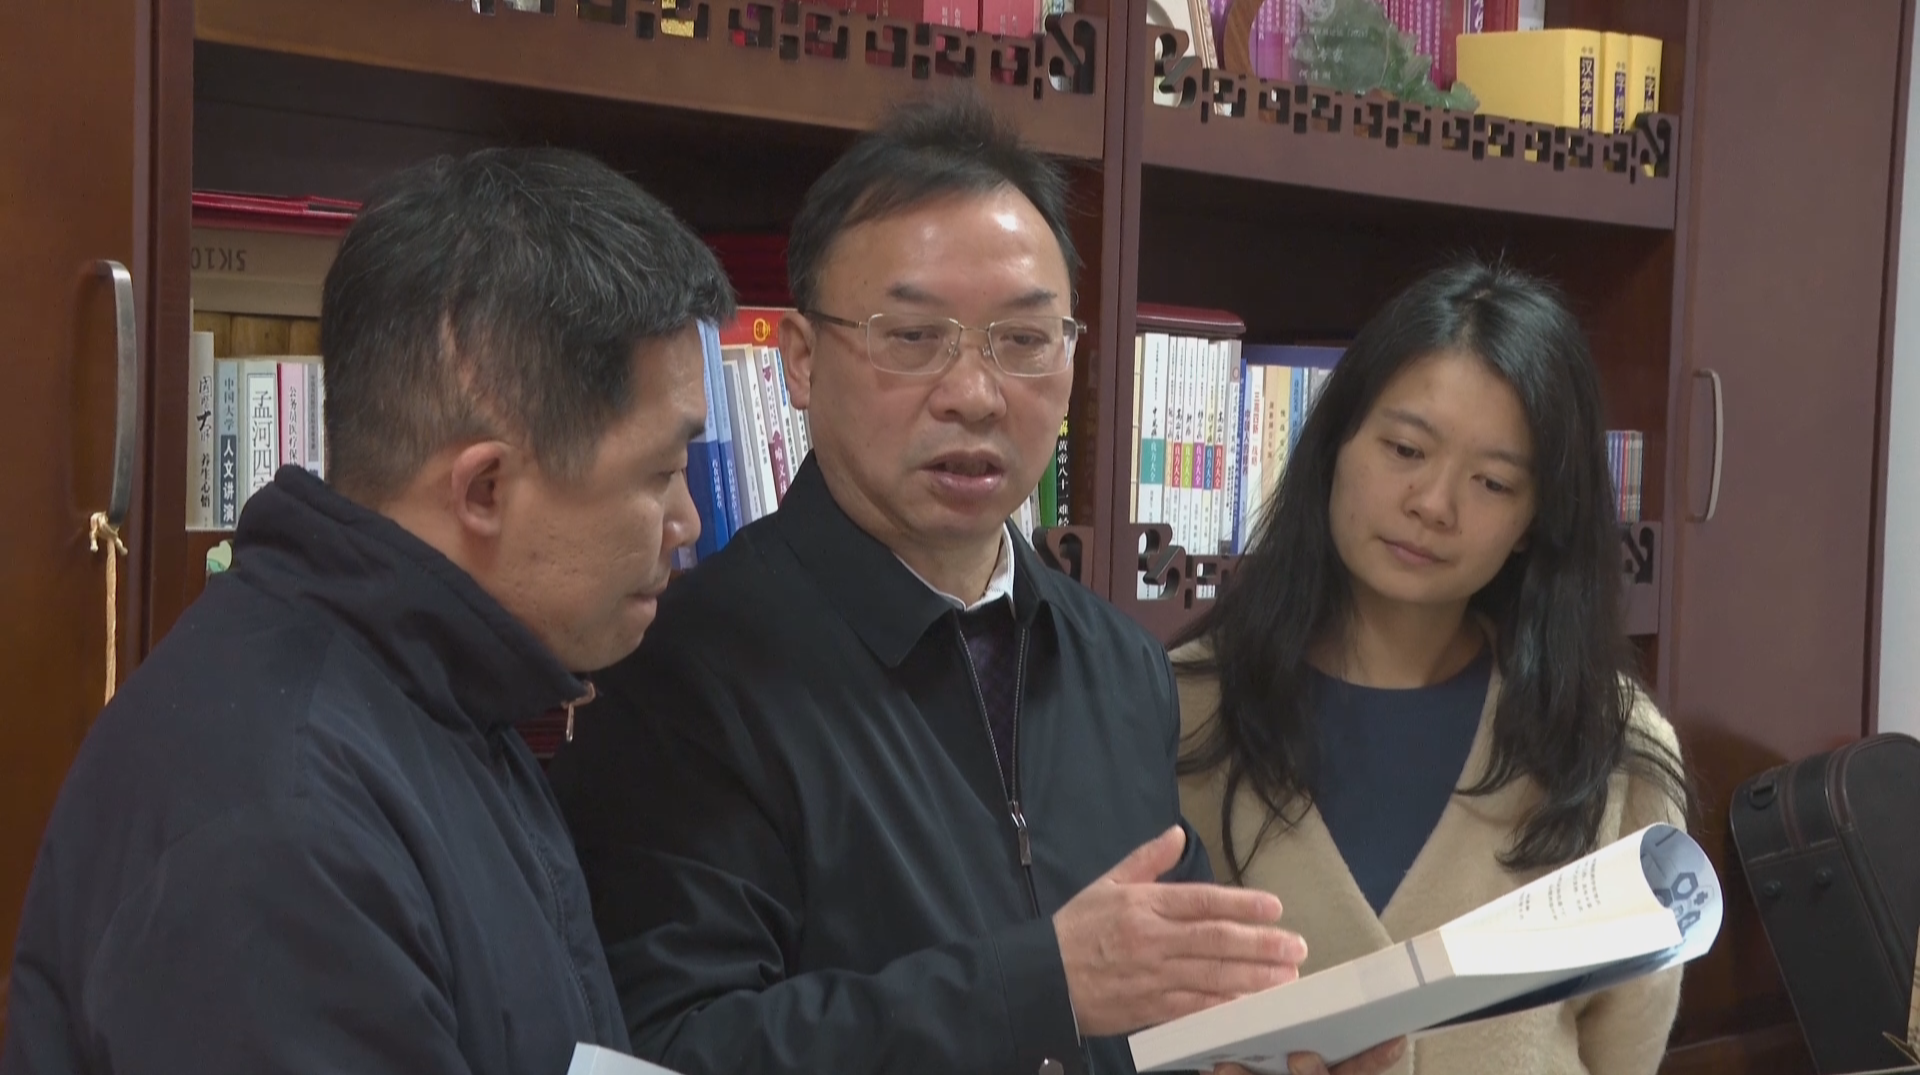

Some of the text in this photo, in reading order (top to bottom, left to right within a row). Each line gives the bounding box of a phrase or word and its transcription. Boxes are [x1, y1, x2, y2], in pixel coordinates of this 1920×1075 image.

[222, 377, 235, 529] 中国大学 人文讲演
[288, 386, 298, 465] 公务员医疗保
